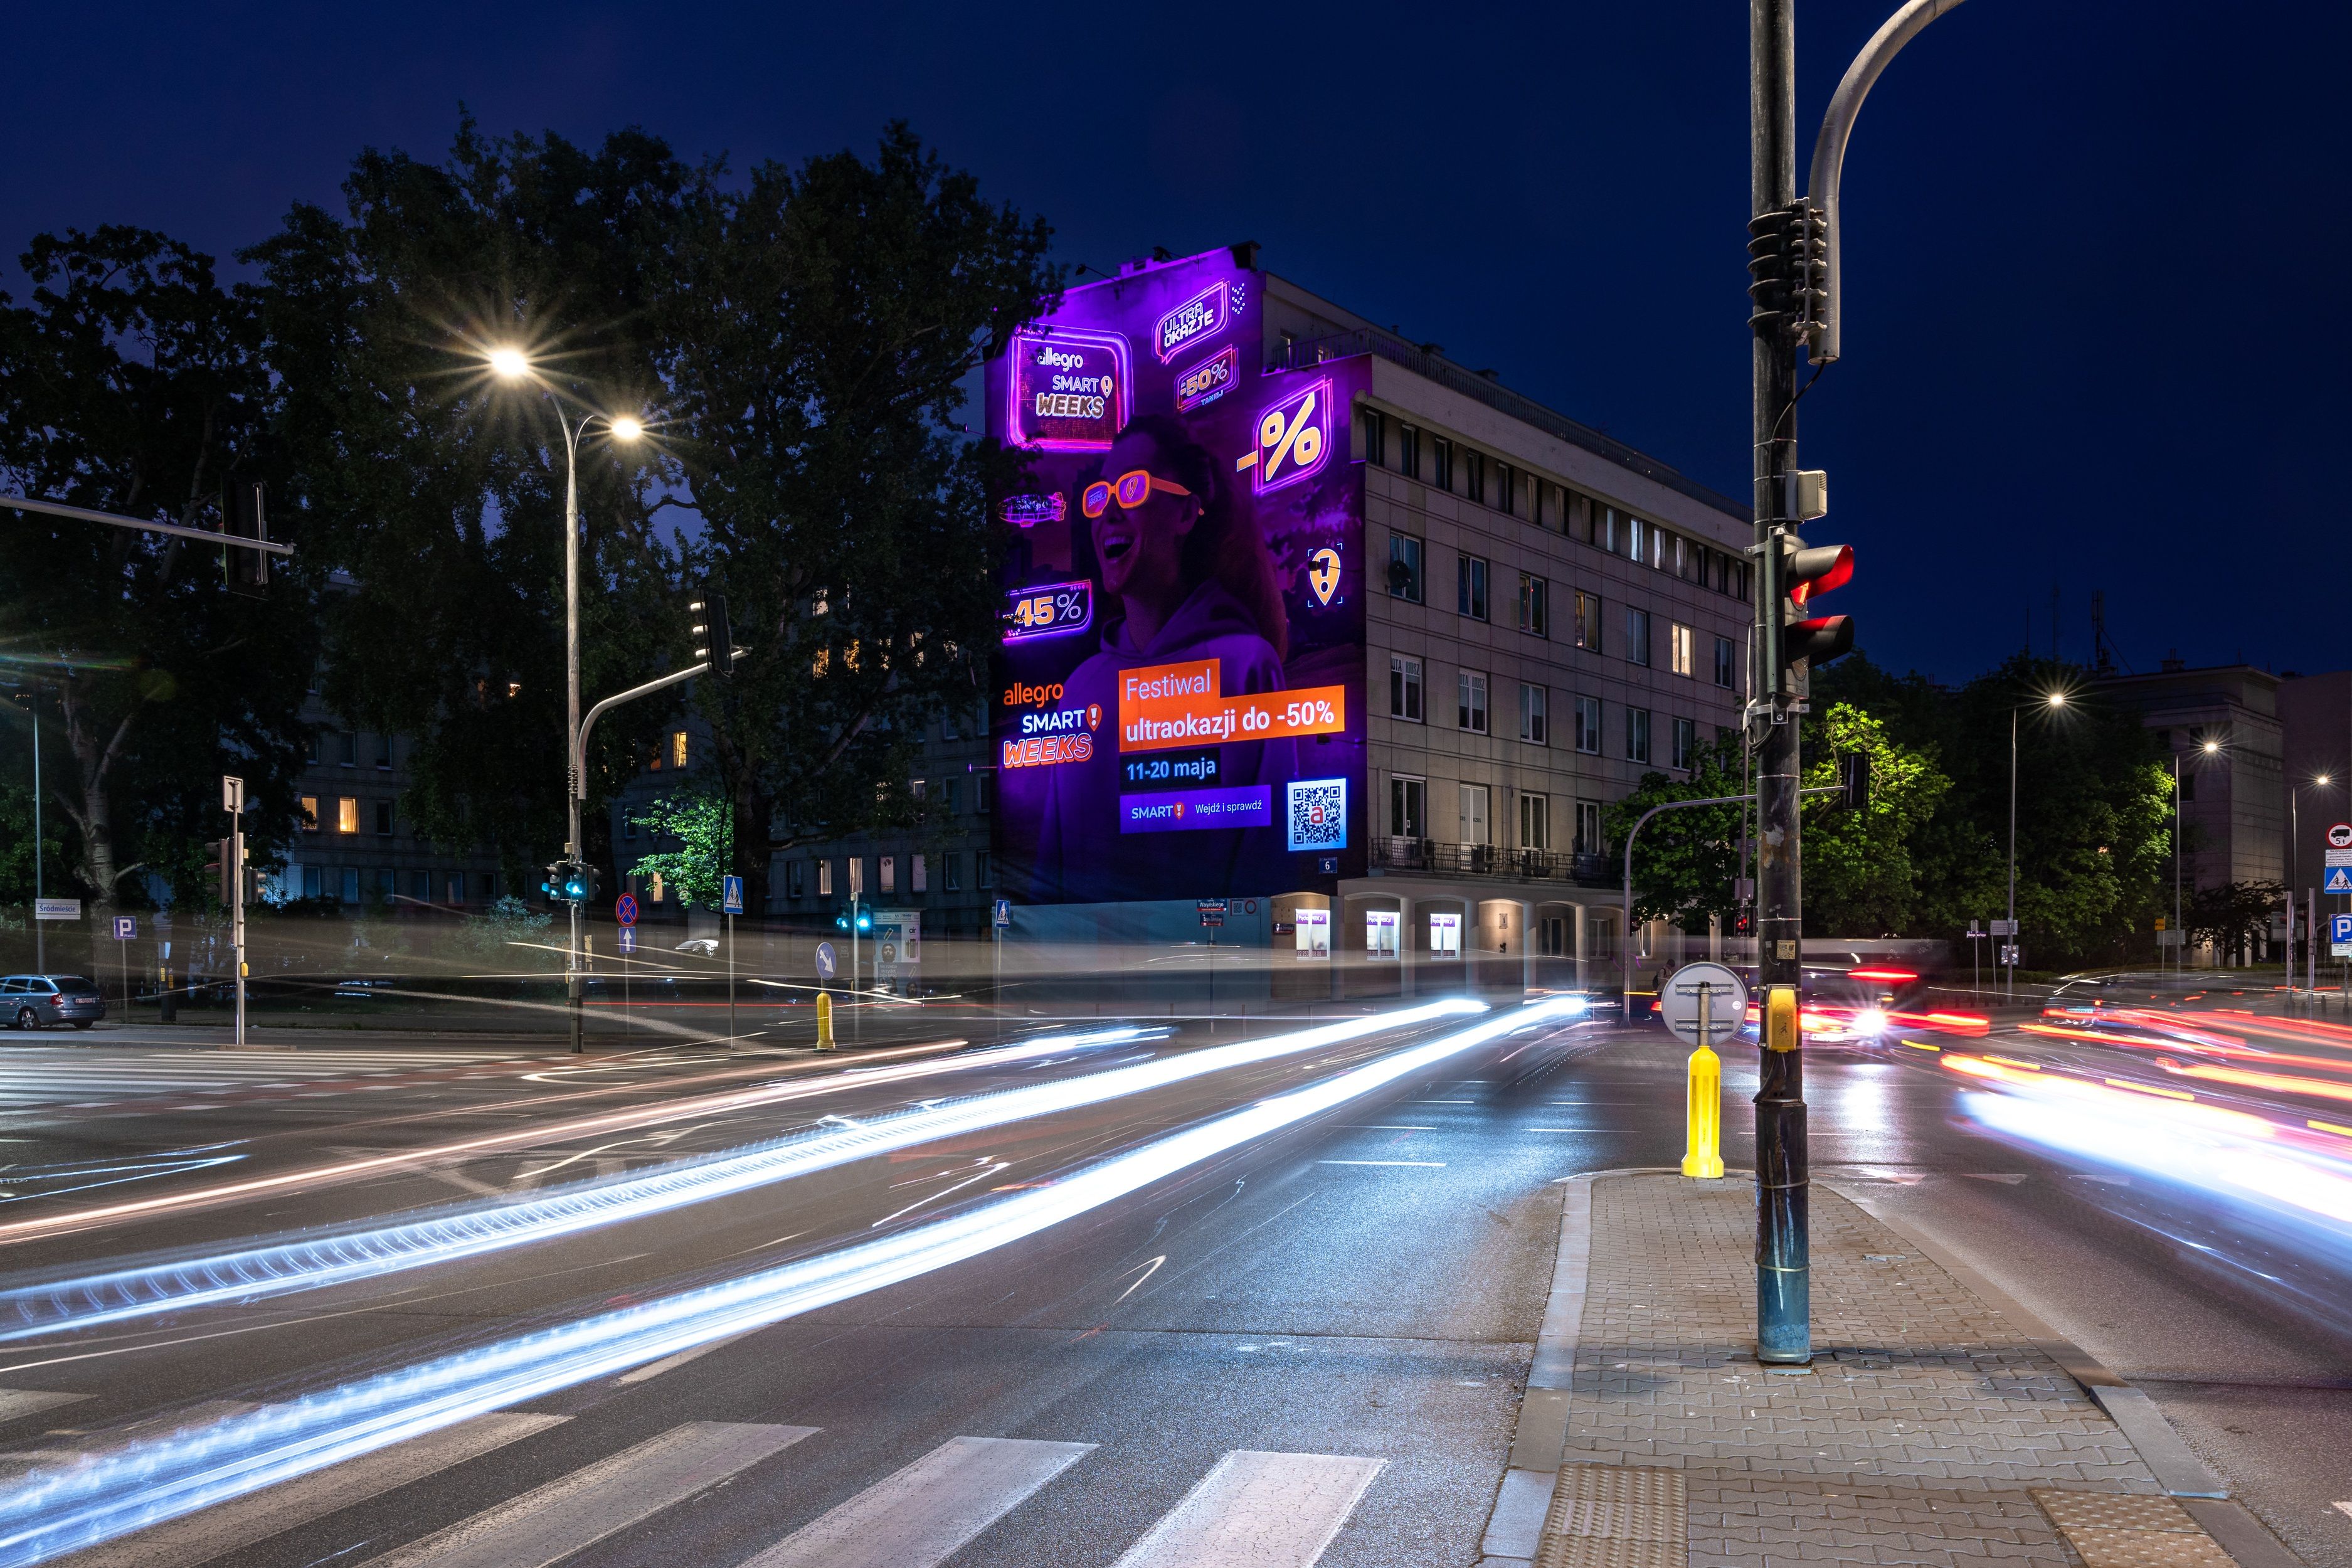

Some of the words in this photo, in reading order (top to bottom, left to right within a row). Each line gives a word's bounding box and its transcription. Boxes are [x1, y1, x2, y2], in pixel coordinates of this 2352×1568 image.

[1164, 302, 1203, 334] ULTRA
[1164, 309, 1214, 347] OKAZJE
[1037, 347, 1083, 372] allegro
[1180, 359, 1228, 396] -50%
[1036, 392, 1104, 419] WEEKS
[1004, 682, 1064, 707] allegro
[1126, 669, 1210, 701] Festiwal
[1126, 709, 1236, 739] ultraokazji
[1242, 706, 1270, 731] do
[1277, 700, 1335, 727] -50%
[1004, 733, 1093, 768] WEEKS
[1127, 761, 1170, 780] 11-20
[1174, 757, 1216, 780] maja
[1195, 802, 1221, 815] Wejdź
[1222, 803, 1225, 812] i
[1227, 800, 1262, 814] sprawdź
[1310, 806, 1323, 824] a
[1325, 861, 1330, 870] 6
[40, 903, 76, 912] Śródmieście
[119, 919, 132, 936] P
[2337, 919, 2352, 938] P
